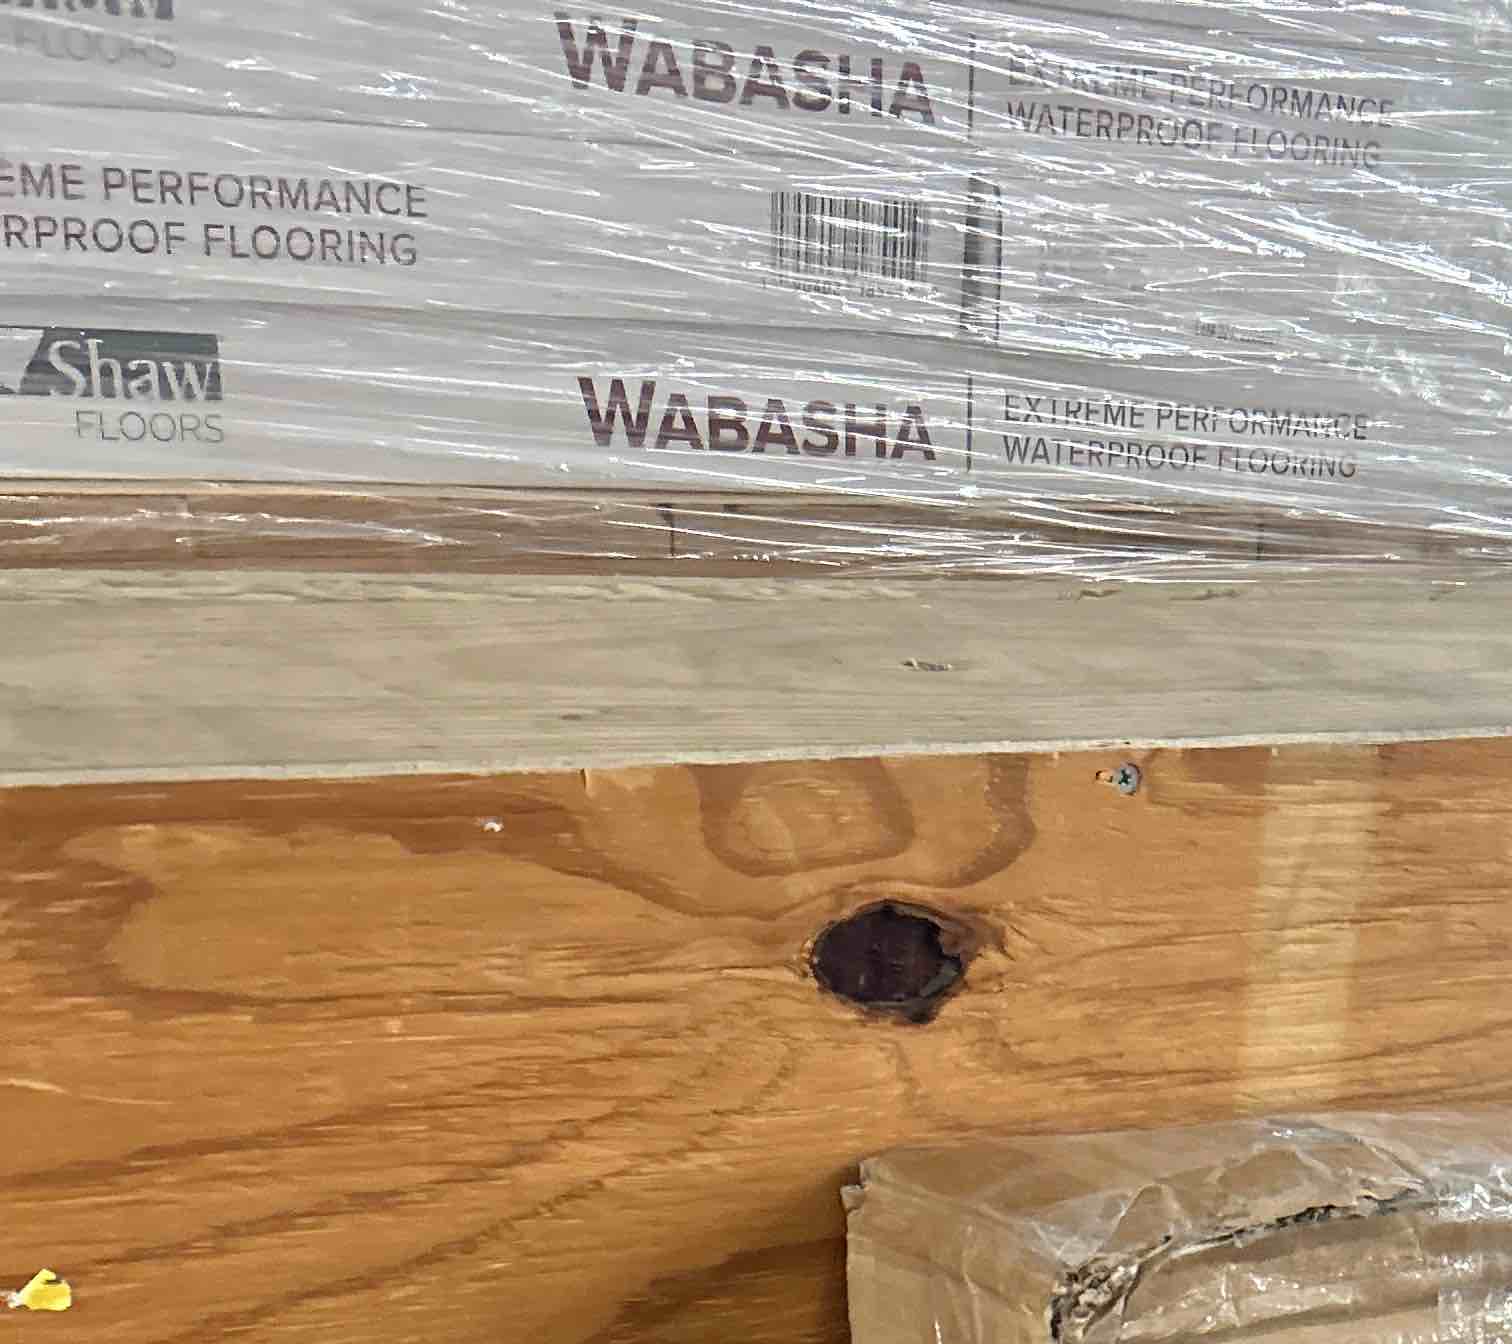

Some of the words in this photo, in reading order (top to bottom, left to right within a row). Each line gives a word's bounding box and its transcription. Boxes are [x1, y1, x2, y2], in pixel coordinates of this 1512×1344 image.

[553, 11, 936, 123] WABASHA
[1006, 99, 1225, 150] WATERPROOF
[1170, 73, 1394, 129] PERFORMANCE
[102, 167, 428, 218] PERFORMANCE
[3, 214, 185, 254] RPROOF
[203, 223, 418, 266] FLOORING
[48, 338, 223, 401] Shaw
[74, 409, 225, 443] FLOORS
[577, 376, 936, 460] WABASHA
[1004, 394, 1146, 428] EXTREME
[1156, 402, 1367, 440] PERFORMANCE
[1002, 435, 1207, 472] WATERPROOF
[1218, 450, 1356, 478] FLOORING
